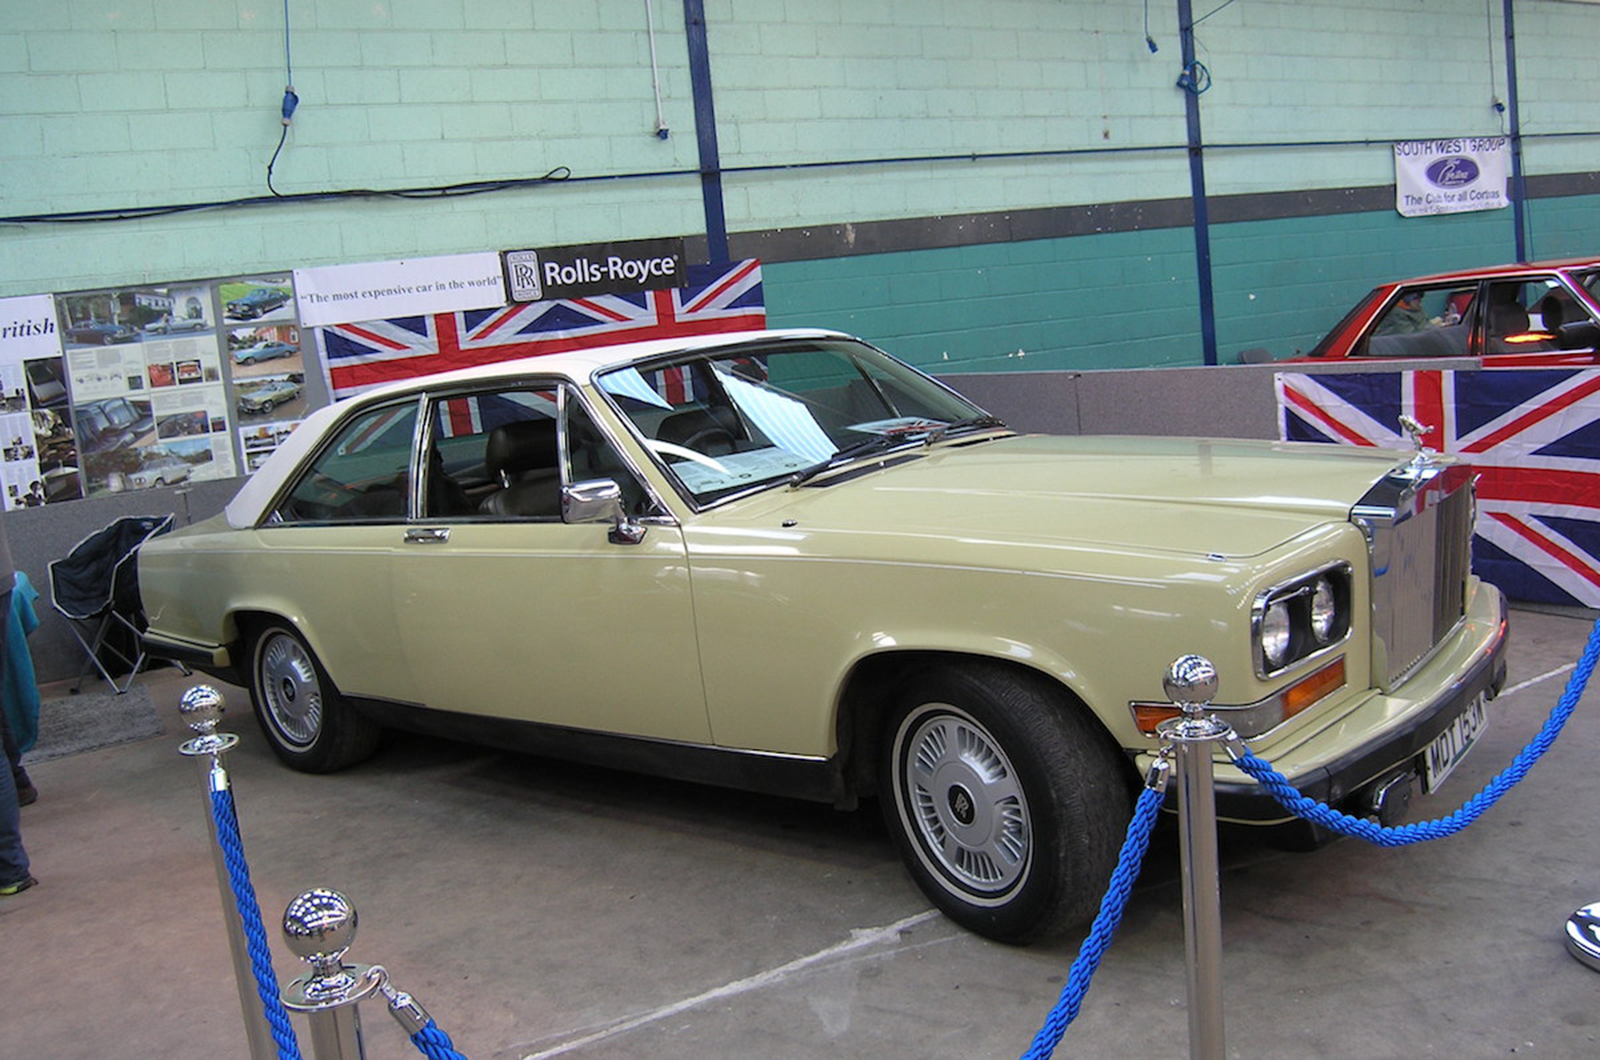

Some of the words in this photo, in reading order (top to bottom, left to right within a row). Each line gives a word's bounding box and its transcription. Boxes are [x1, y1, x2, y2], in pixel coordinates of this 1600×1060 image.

[1396, 141, 1433, 156] SOUTH
[1435, 139, 1467, 154] WEST
[1469, 138, 1506, 152] GROUP
[1405, 195, 1422, 206] The
[1443, 192, 1456, 203] for
[543, 256, 675, 286] Rolls-Royce
[332, 290, 359, 301] most
[361, 285, 413, 299] expensive
[415, 283, 433, 293] car
[435, 281, 446, 291] in
[448, 280, 465, 290] the
